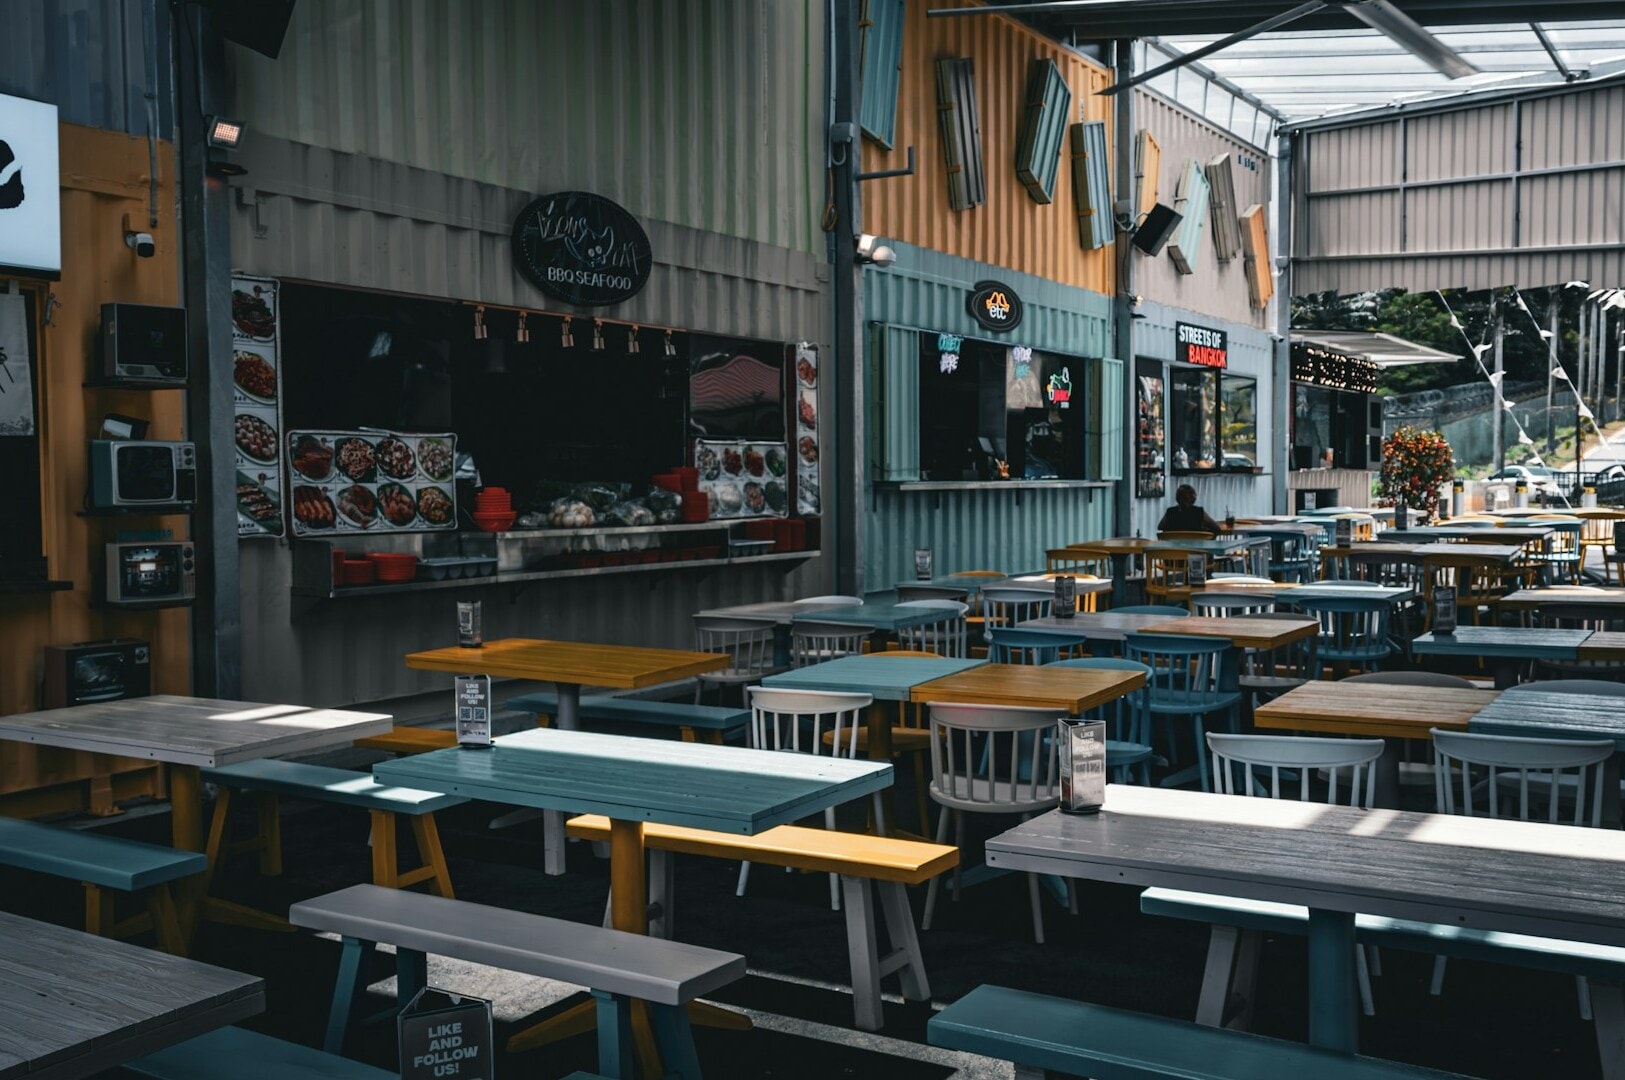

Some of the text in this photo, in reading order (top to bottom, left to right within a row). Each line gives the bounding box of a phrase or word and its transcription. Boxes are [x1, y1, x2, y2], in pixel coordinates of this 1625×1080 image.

[548, 266, 632, 290] BBQ SEAFOOD
[989, 304, 1007, 320] etc
[1179, 324, 1222, 348] STREETS OF
[1188, 344, 1227, 368] BANGKOK
[428, 1022, 462, 1038] LIKE
[429, 1036, 463, 1052] AND
[413, 1046, 479, 1068] FOLLOW
[434, 1062, 460, 1077] US!
